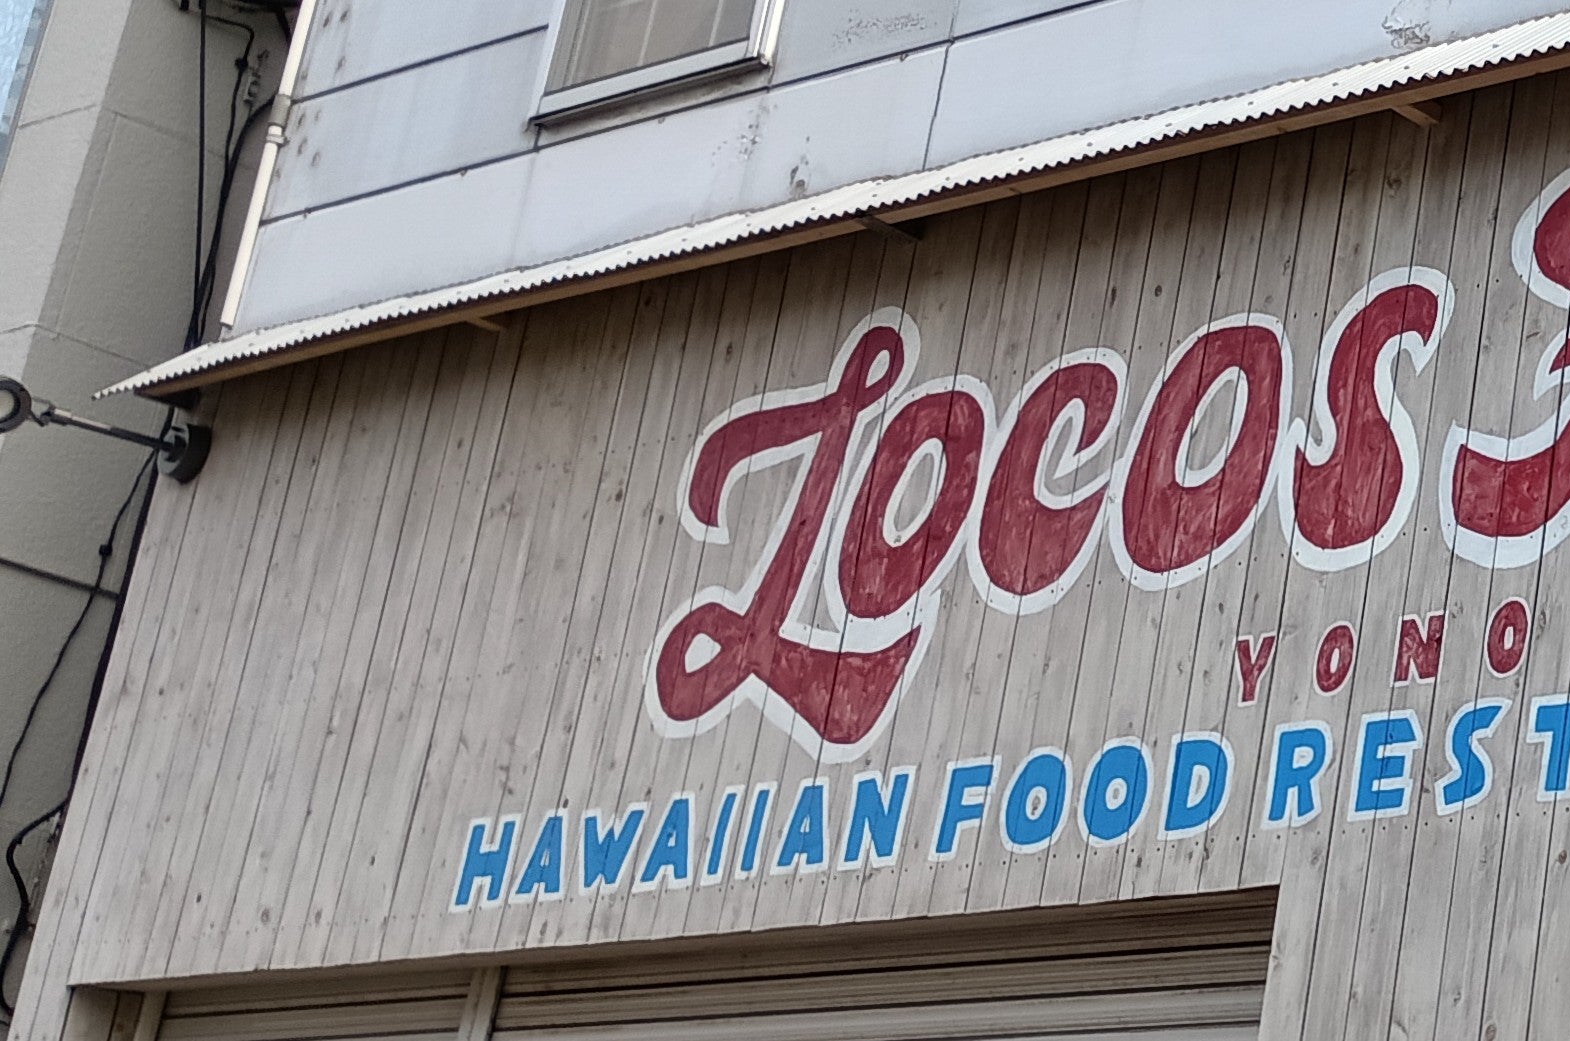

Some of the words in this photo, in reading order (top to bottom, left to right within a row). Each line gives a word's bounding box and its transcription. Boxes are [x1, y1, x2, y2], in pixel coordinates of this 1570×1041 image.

[644, 265, 1453, 763] Locos
[1235, 596, 1532, 707] YONO
[448, 766, 916, 913] HAWAIIAN
[929, 732, 1235, 863] FOOD
